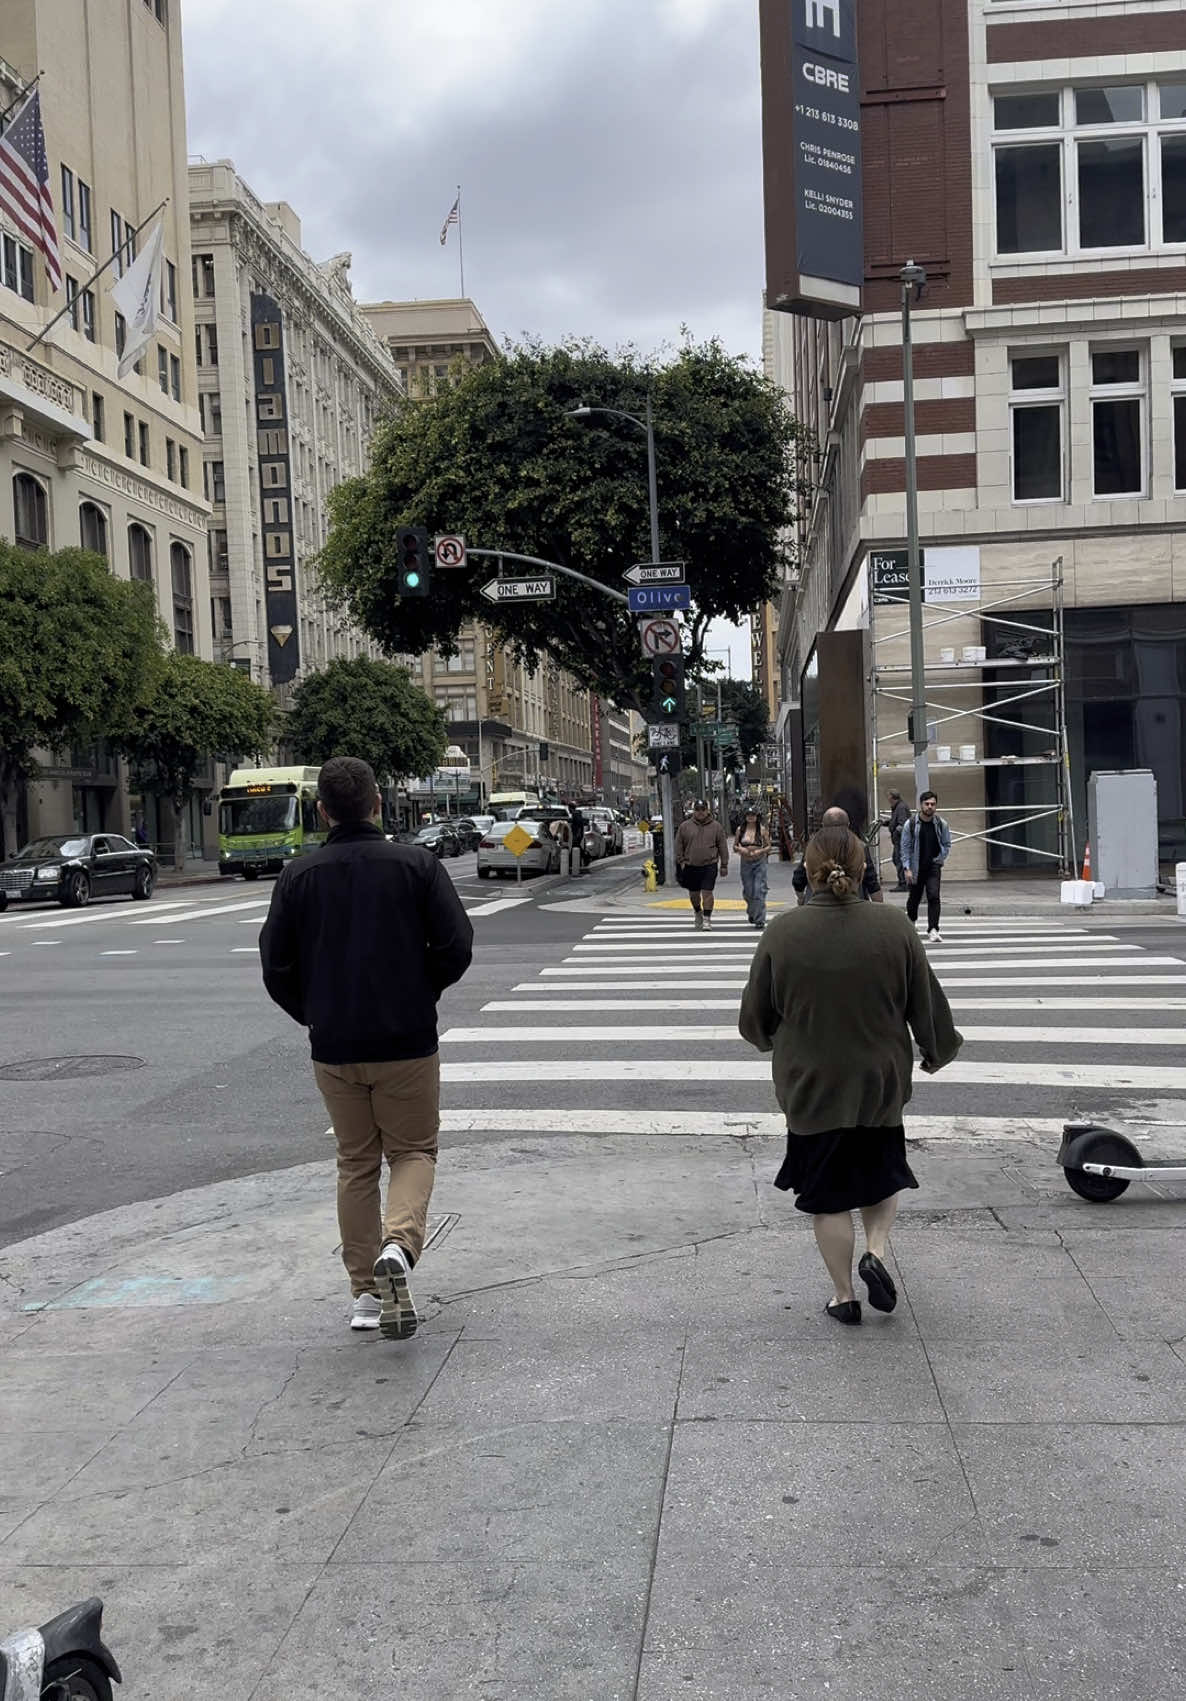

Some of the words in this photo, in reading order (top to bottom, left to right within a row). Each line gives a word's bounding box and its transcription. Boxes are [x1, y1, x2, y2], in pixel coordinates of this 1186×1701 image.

[802, 62, 850, 93] CBRE
[805, 106, 820, 119] 213
[821, 111, 836, 125] 613
[837, 116, 859, 131] 3308
[800, 141, 822, 155] CHRIS
[823, 148, 856, 165] PENROSE
[804, 188, 824, 201] KELLI
[825, 194, 854, 208] SNYDER
[873, 557, 896, 570] For
[640, 569, 658, 578] ONE
[659, 568, 679, 577] WAY
[955, 577, 977, 585] Moore
[497, 584, 519, 596] ONE
[526, 582, 548, 594] WAY
[636, 591, 684, 605] Olive
